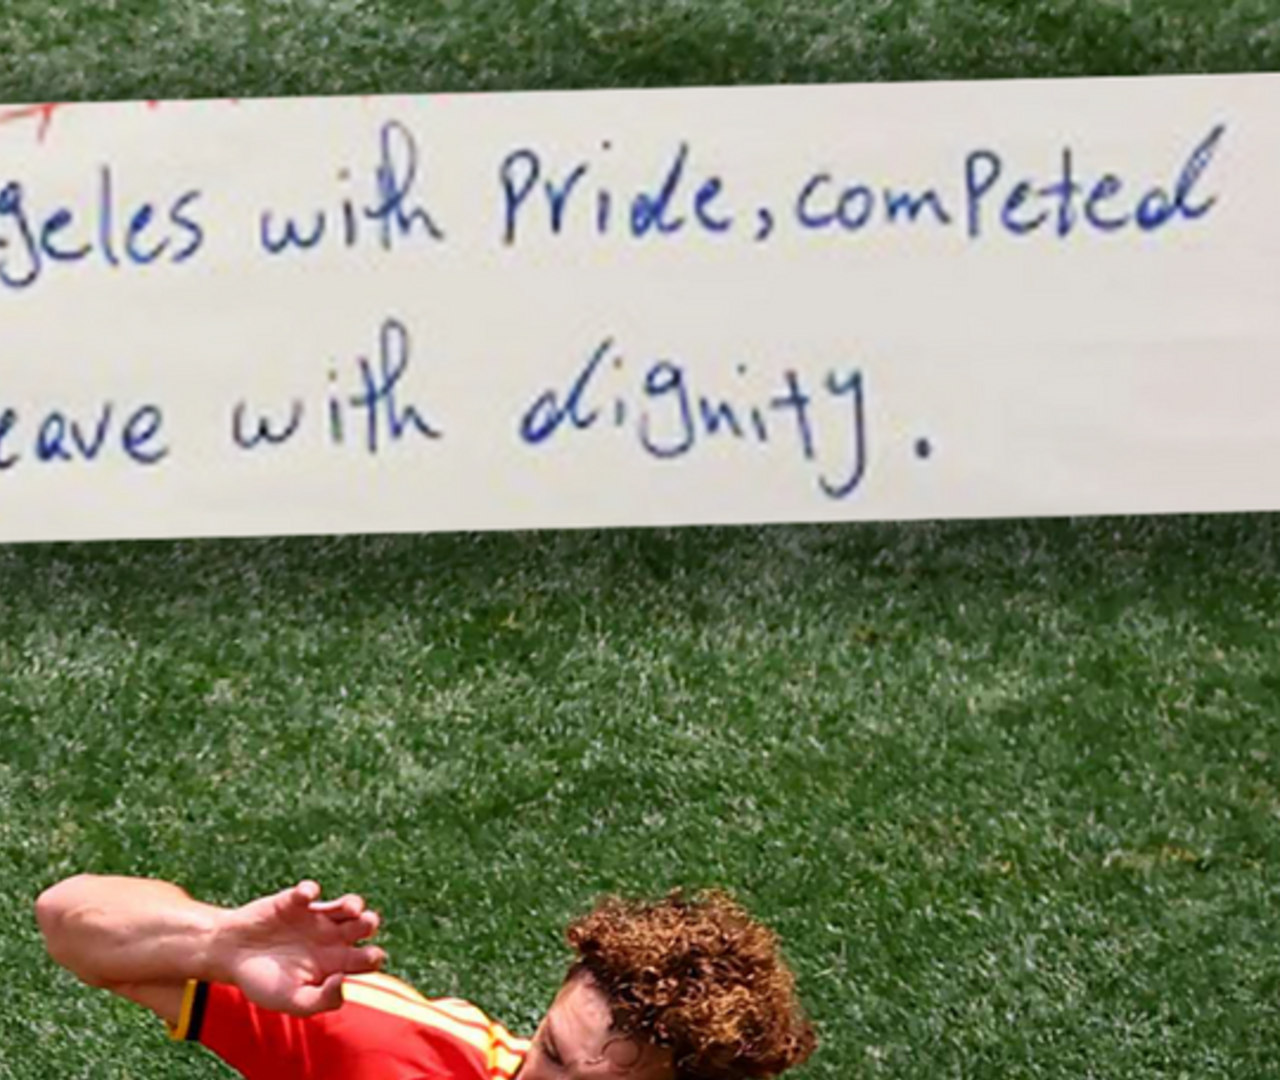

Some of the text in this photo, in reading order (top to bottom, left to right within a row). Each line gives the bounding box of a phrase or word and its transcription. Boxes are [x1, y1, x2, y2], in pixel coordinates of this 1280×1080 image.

[260, 120, 444, 255] with
[232, 318, 441, 454] with
[518, 339, 932, 500] dignity.
